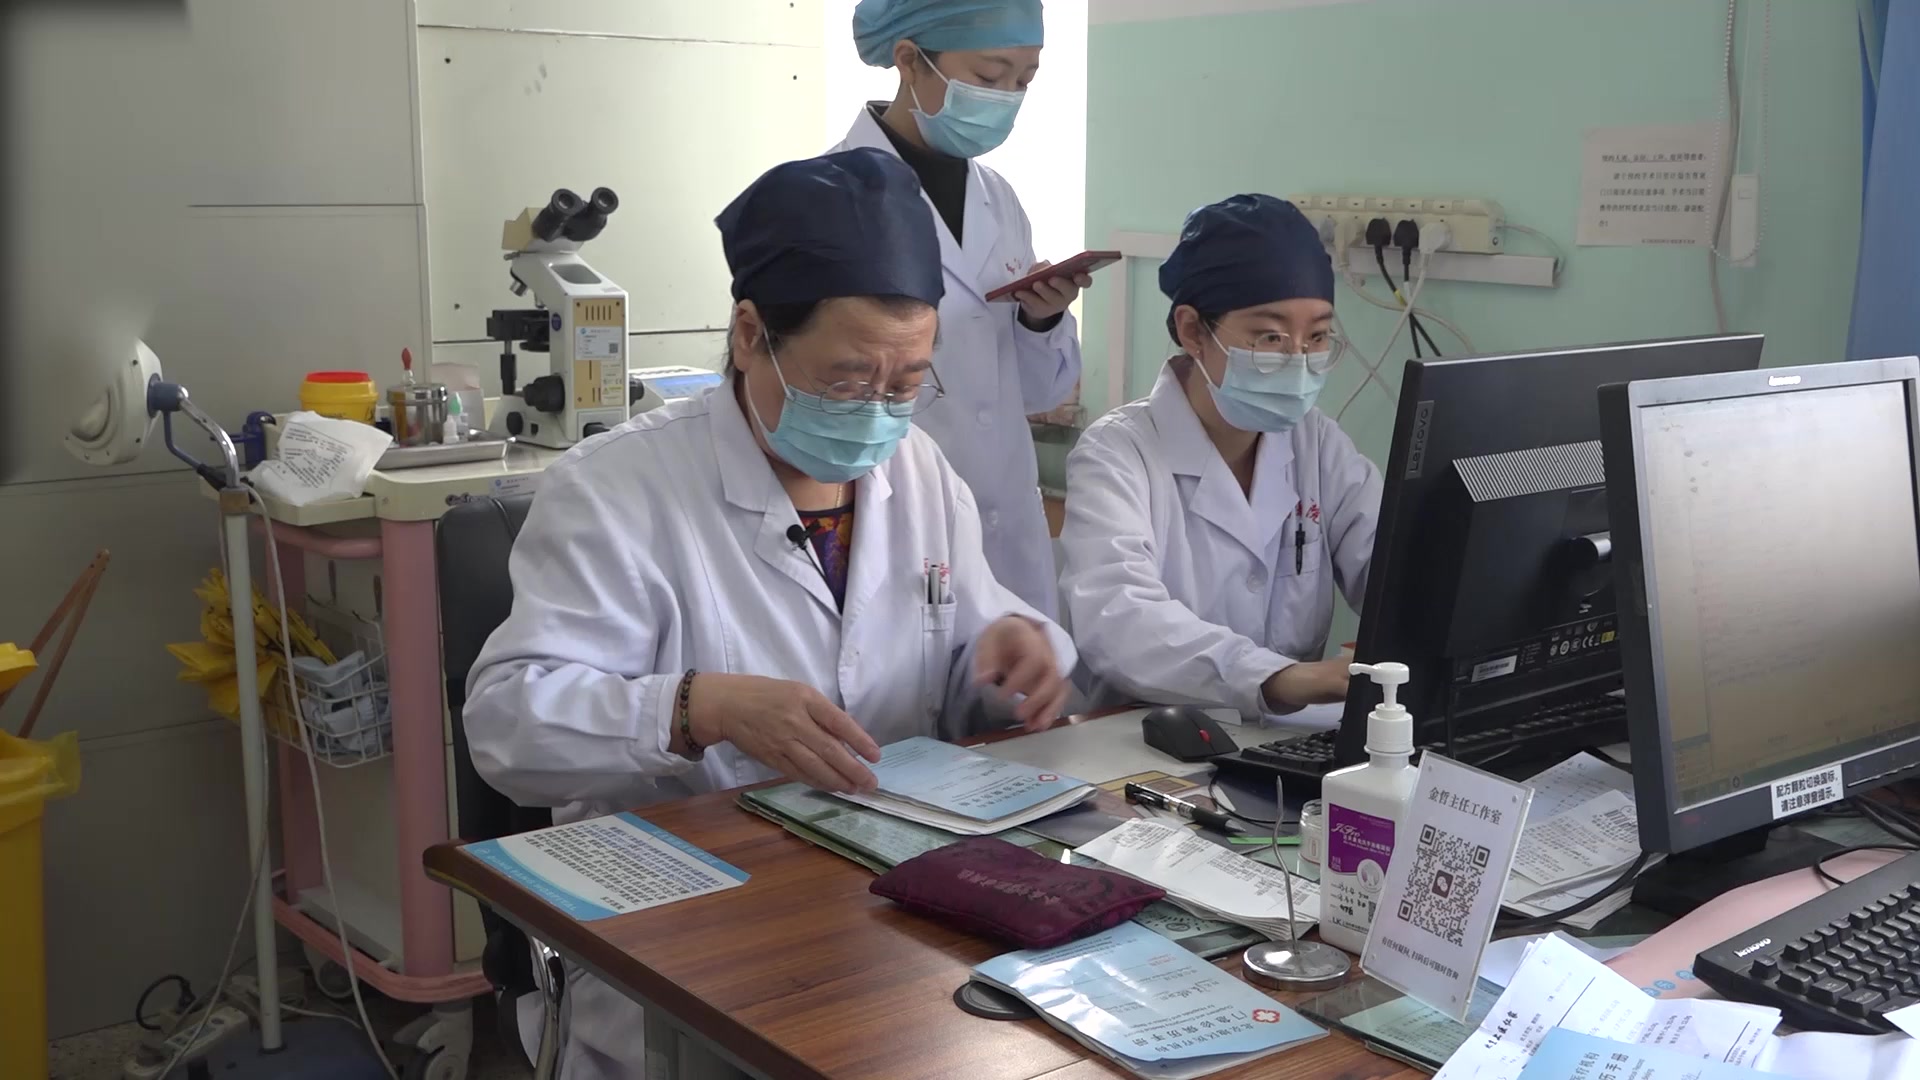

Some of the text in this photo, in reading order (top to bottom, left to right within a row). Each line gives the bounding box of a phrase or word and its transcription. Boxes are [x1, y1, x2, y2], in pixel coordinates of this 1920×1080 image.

[1428, 786, 1503, 826] 金哲主任工作室
[1733, 938, 1772, 958] lenovo
